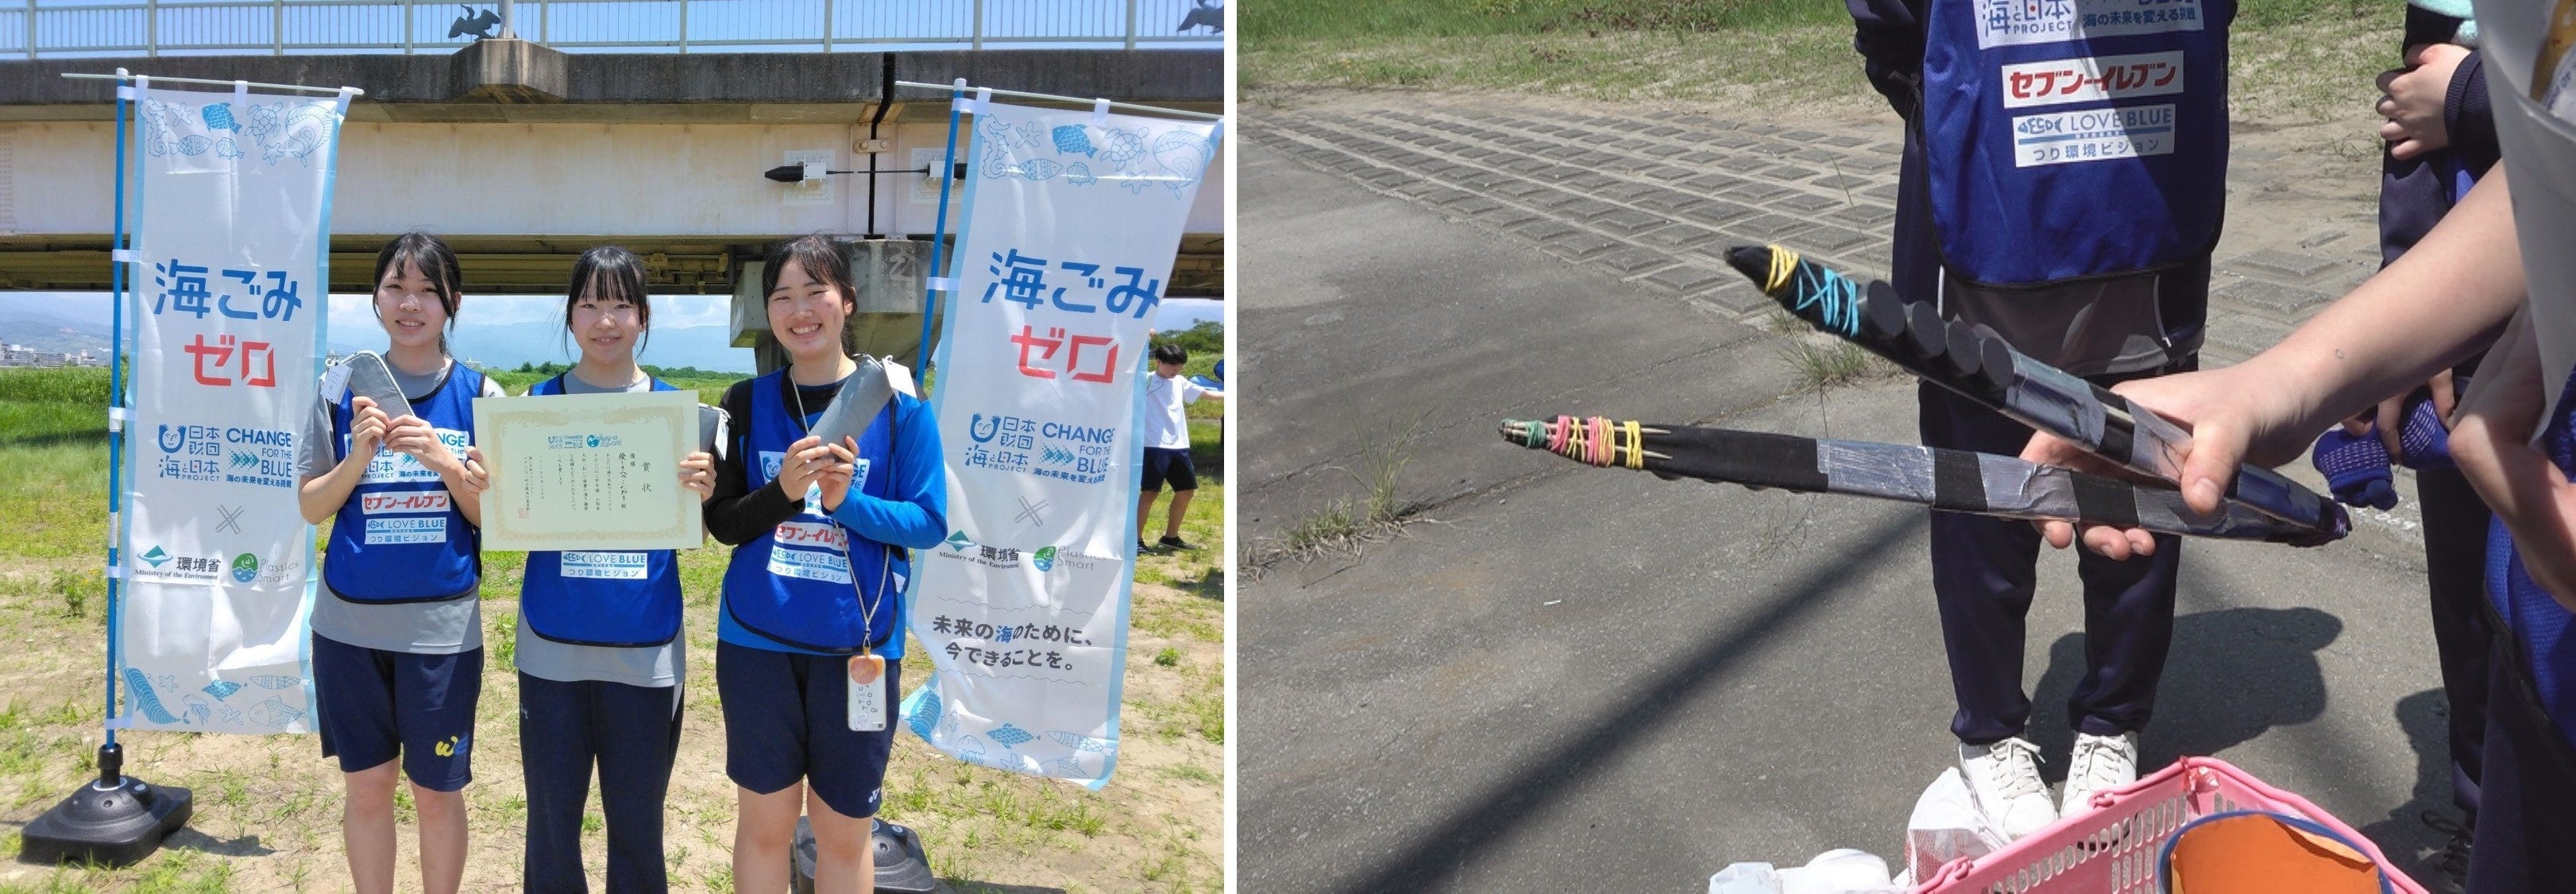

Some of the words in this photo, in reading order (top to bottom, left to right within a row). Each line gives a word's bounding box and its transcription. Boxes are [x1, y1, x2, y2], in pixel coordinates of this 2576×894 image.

[2084, 6, 2196, 27] 海の未来を変える挑戦
[2013, 21, 2072, 34] PROJECT
[2071, 111, 2122, 131] LOVE
[2126, 109, 2171, 126] BLUE
[2033, 140, 2159, 161] つり環境ビジョン
[153, 258, 302, 321] 海ごみ
[981, 248, 1160, 319] 海ごみ
[184, 334, 276, 387] ゼロ
[1010, 324, 1119, 384] ゼロ
[1002, 416, 1036, 433] 日本
[189, 426, 220, 440] 日本
[226, 428, 292, 447] CHANGE
[437, 433, 465, 447] NGE
[189, 441, 220, 456] 財団
[1000, 433, 1033, 450] 財団
[262, 448, 279, 458] FOR
[281, 449, 292, 460] THE
[965, 444, 1029, 468] 海と日本
[1079, 445, 1102, 456] FOR
[158, 455, 220, 479] 海と日本
[261, 460, 292, 478] BLUE
[988, 463, 1027, 473] PROJECT
[1076, 457, 1108, 474] BLUE
[226, 474, 292, 488] 海の未来を変える挑戦
[641, 461, 652, 492] 賞状
[388, 520, 415, 528] LOVE
[418, 519, 444, 528] BLUE
[371, 534, 437, 543] つり環境ビジョン
[590, 554, 616, 563] LOVE
[619, 555, 645, 563] BLUE
[800, 553, 825, 564] LOVE
[828, 556, 847, 568] BLUE
[939, 552, 967, 561] Ministry
[980, 545, 1020, 562] 環境省
[176, 557, 221, 573] 環境省
[260, 559, 299, 573] Plastics
[1057, 556, 1094, 570] Smart
[258, 570, 290, 582] Smart
[776, 566, 842, 581] つり環境ビジョン
[933, 614, 1092, 646] 未来の海のために、
[945, 641, 1073, 671] 今できることを。
